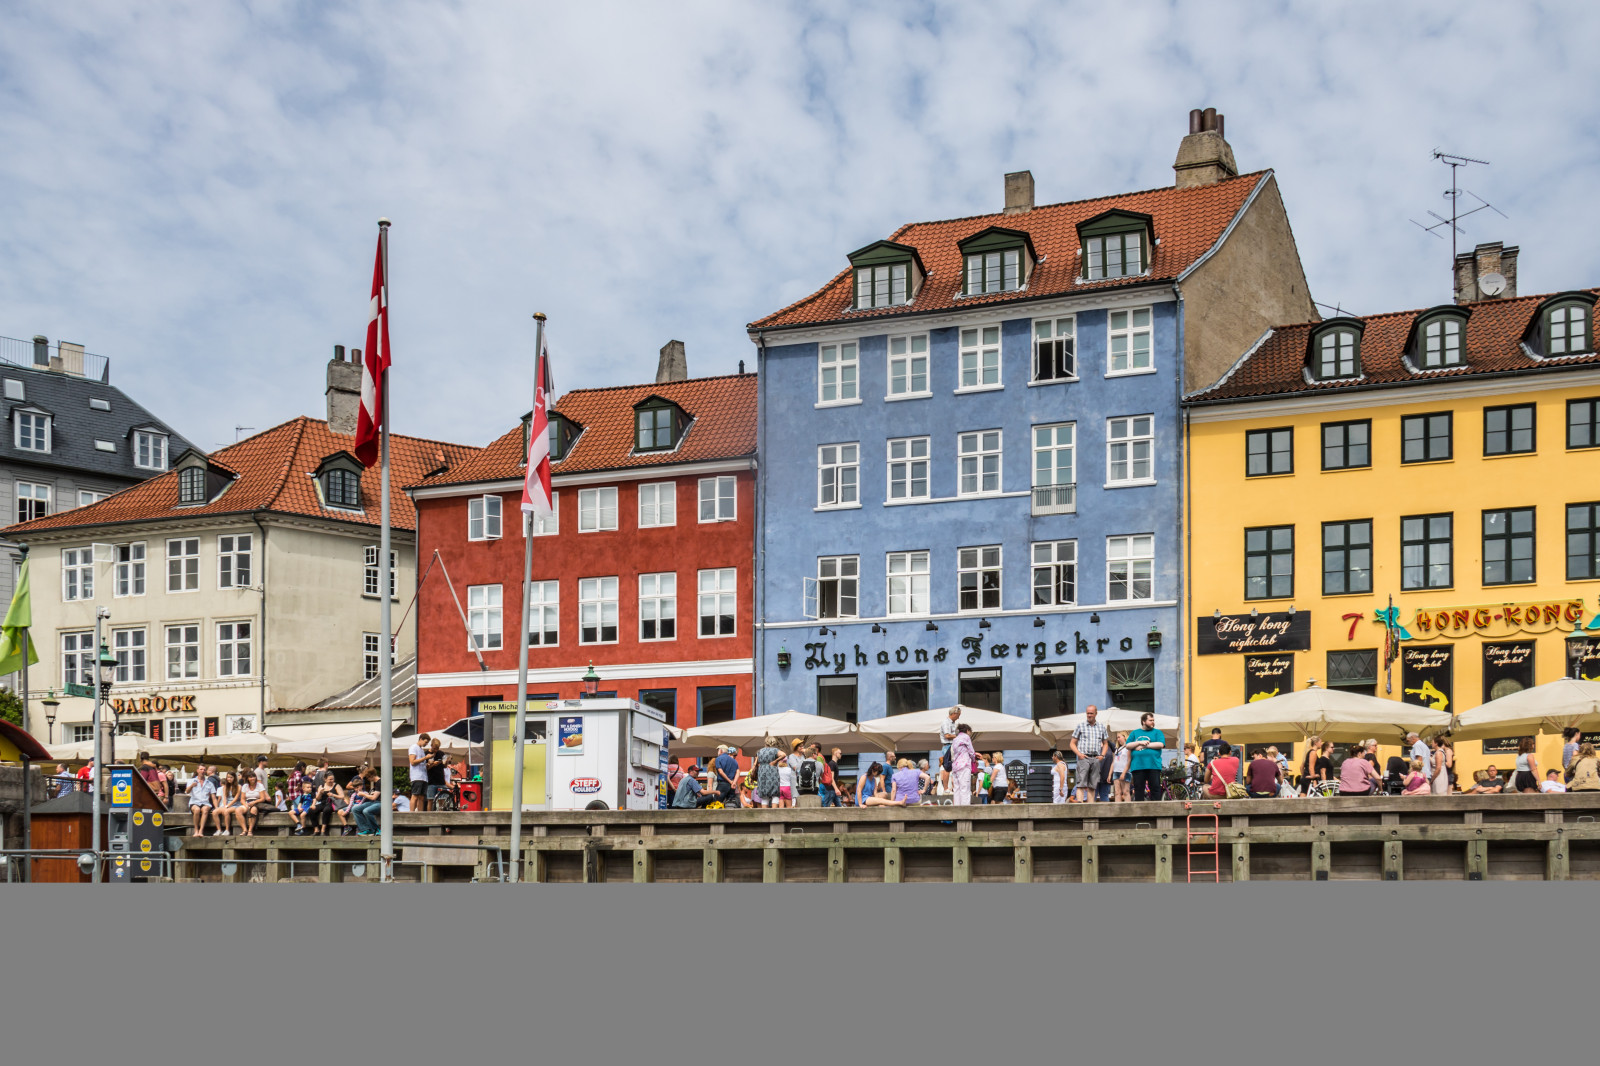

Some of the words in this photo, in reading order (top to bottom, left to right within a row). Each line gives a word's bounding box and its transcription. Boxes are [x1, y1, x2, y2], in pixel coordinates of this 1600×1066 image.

[1416, 602, 1583, 631] HONG-KONG
[1215, 616, 1257, 640] Hong
[1258, 615, 1291, 635] kong
[1341, 612, 1364, 641] 7
[1228, 634, 1277, 651] nightclub
[804, 642, 949, 674] Nyhavns
[1404, 649, 1430, 664] Hong
[1430, 650, 1450, 661] kong
[1485, 645, 1511, 660] Hong
[1511, 645, 1531, 657] kong
[1247, 658, 1271, 672] Hong
[1271, 657, 1291, 669] kong
[113, 695, 196, 714] BAROCK
[498, 702, 519, 710] Micha
